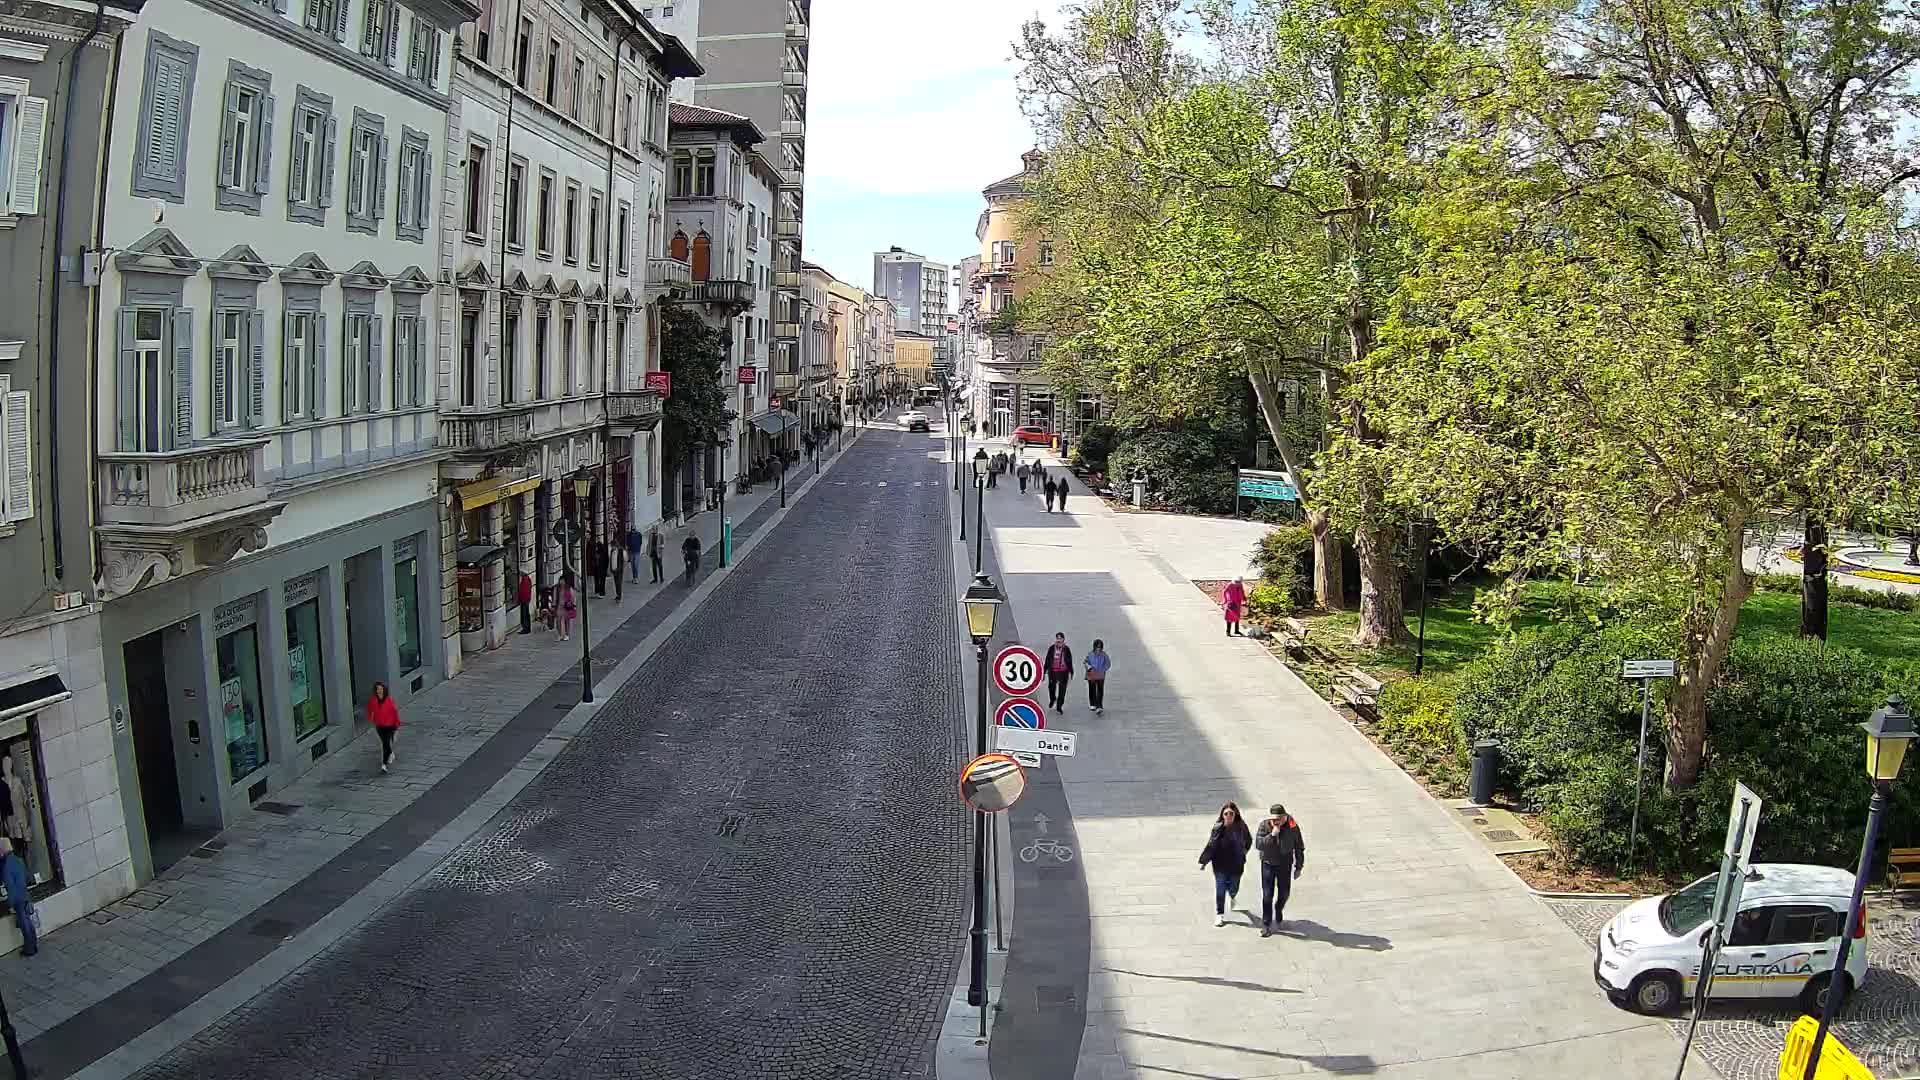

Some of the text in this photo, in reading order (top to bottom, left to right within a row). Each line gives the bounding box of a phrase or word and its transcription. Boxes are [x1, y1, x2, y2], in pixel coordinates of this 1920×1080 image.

[1005, 660, 1032, 683] 30
[222, 680, 240, 704] 130
[1038, 740, 1069, 752] Dante
